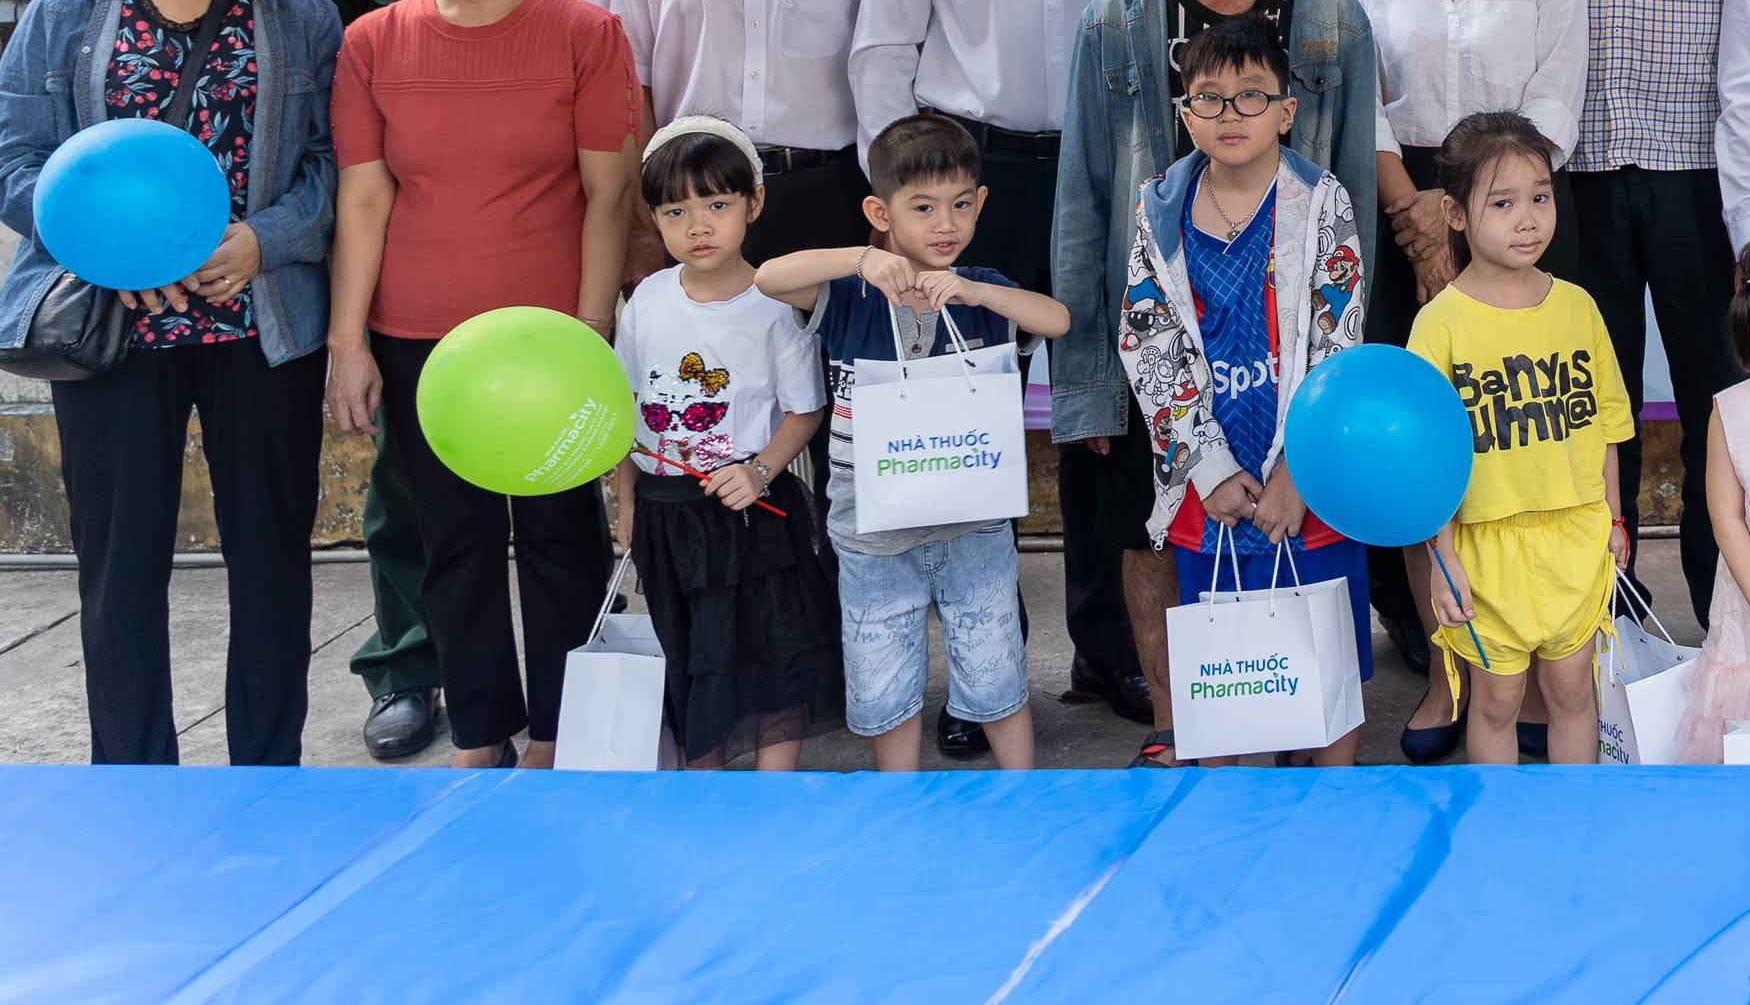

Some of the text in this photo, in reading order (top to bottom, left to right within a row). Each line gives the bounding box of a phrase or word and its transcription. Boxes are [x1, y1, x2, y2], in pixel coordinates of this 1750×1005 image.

[887, 429, 990, 453] NHÀ THUỐC
[877, 448, 1002, 476] Pharmacity
[1200, 653, 1289, 676] NHÀ THUỐC
[1190, 672, 1298, 699] Pharmacity
